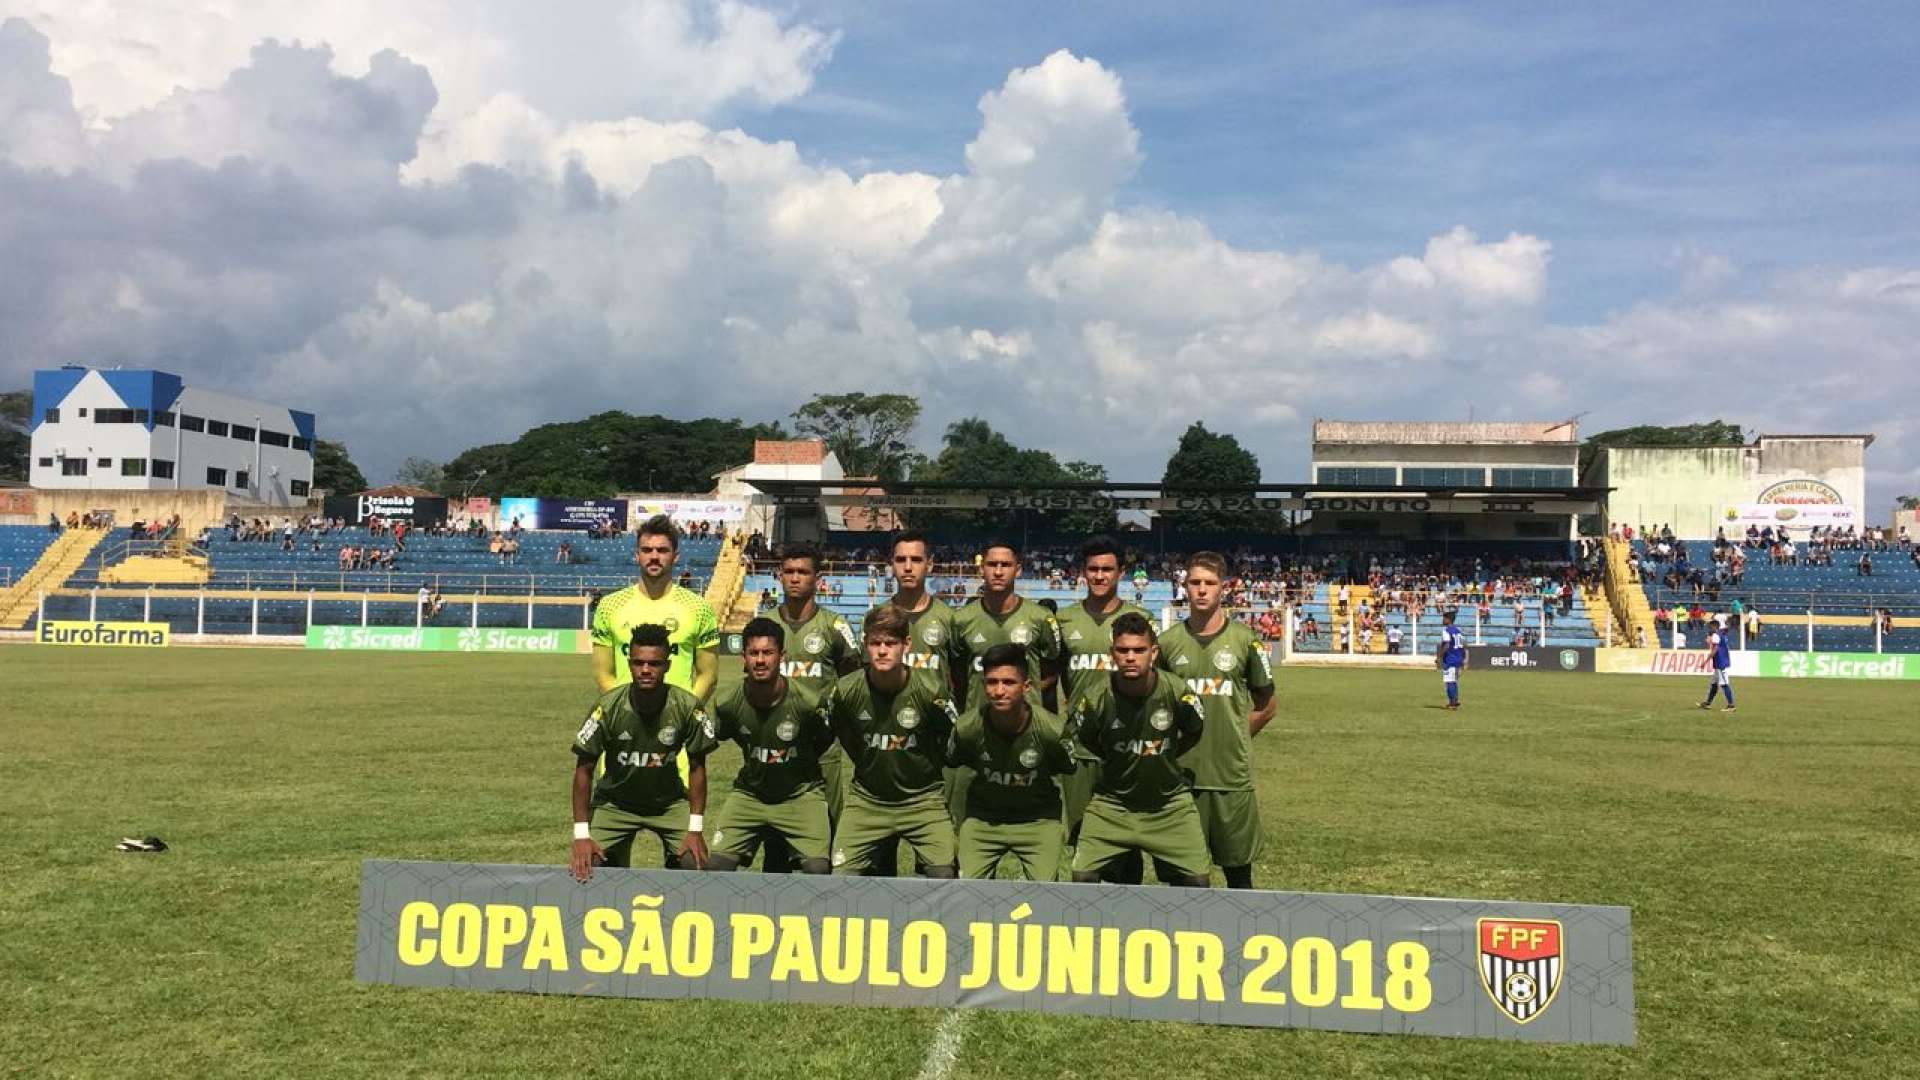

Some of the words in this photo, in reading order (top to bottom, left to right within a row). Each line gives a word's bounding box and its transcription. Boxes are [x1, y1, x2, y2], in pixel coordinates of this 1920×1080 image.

[1304, 498, 1429, 511] BONITO
[41, 622, 163, 645] Eurofarma
[351, 629, 424, 650] Sicredi
[485, 630, 558, 651] Sicredi
[1814, 655, 1905, 678] Sicredi
[1186, 675, 1232, 697] AIXA
[1488, 925, 1549, 951] FPF
[398, 901, 567, 971] COPA
[581, 894, 714, 977] SÃO
[730, 913, 946, 989] PAULO
[959, 904, 1224, 1001] JÚNIOR
[1241, 936, 1431, 1013] 2018
